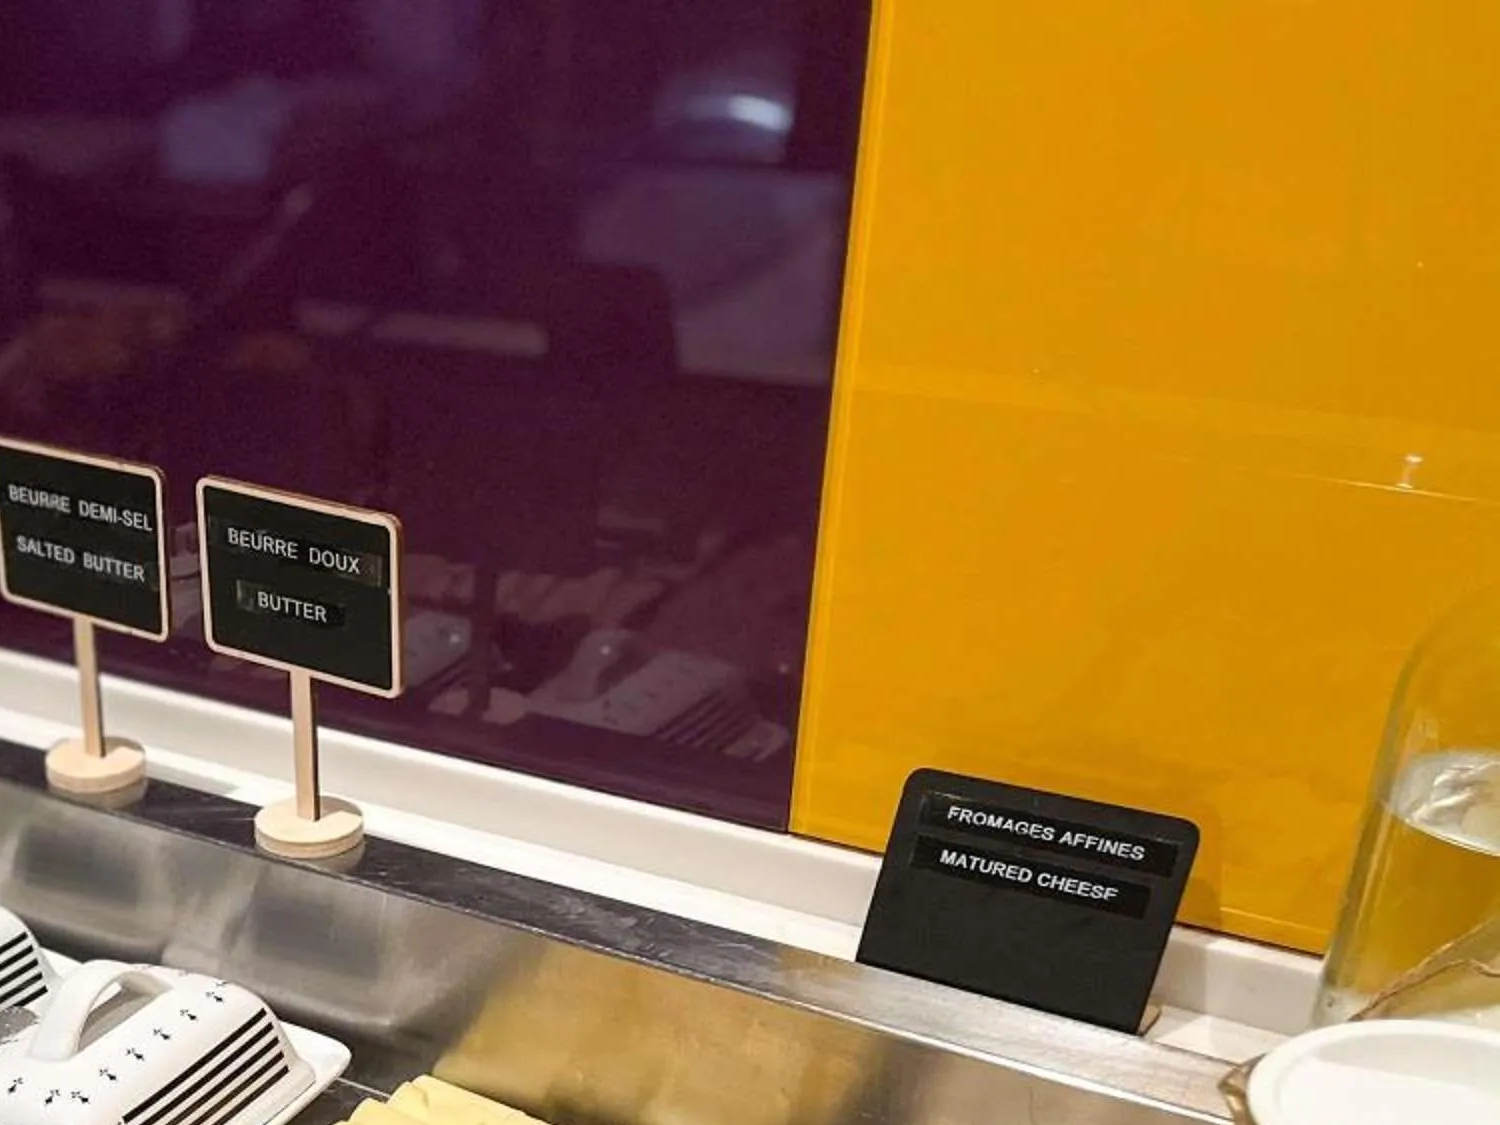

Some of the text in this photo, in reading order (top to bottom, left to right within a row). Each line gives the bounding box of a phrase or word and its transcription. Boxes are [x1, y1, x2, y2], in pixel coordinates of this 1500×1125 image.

[7, 484, 153, 532] BEURRE DEMI-SEL
[16, 535, 145, 583] SALTED BUTTER
[227, 527, 361, 575] BEURRE DOUX
[257, 591, 327, 623] BUTTER
[947, 805, 1146, 861] FROMAGES AFFINES
[940, 849, 1033, 884] MATURED
